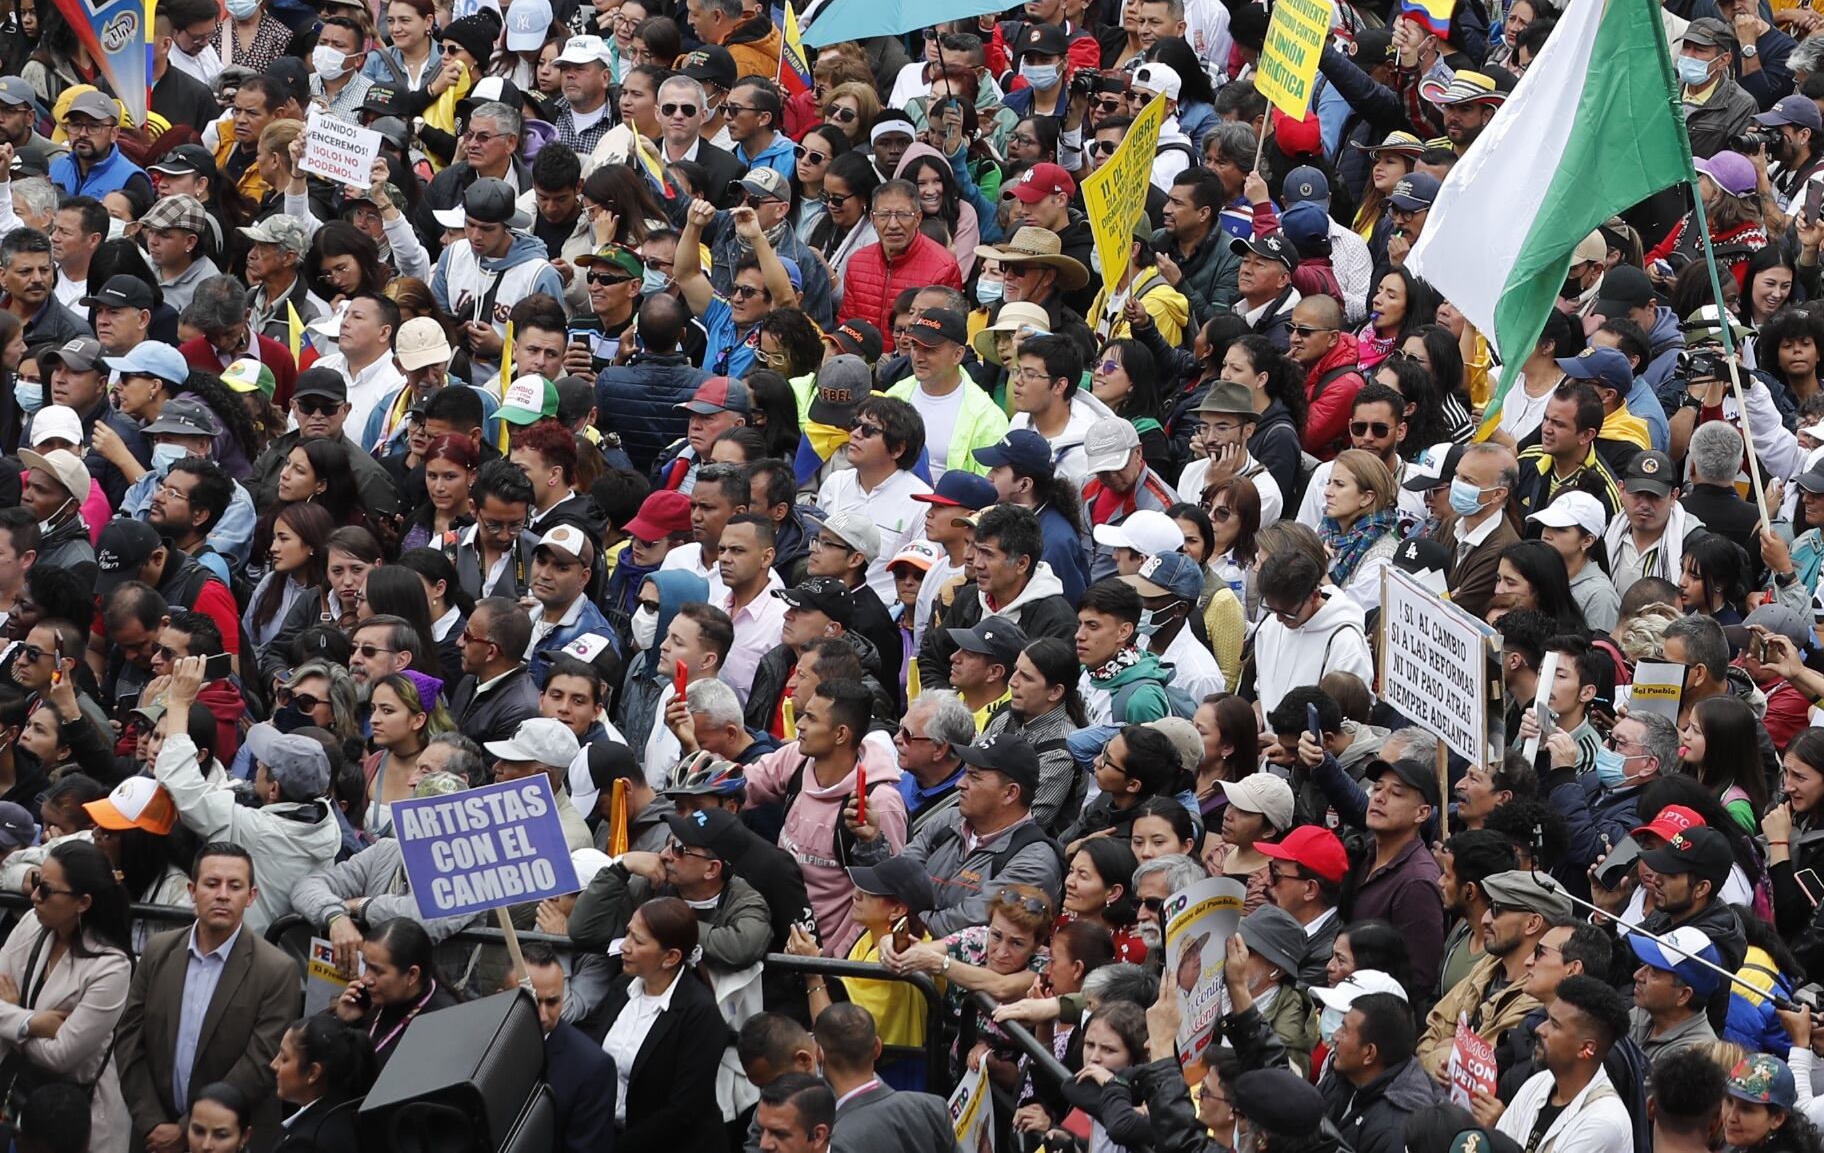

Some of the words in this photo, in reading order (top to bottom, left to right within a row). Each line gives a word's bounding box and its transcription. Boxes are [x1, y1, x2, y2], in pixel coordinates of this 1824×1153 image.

[783, 48, 805, 76] OMBIA
[307, 129, 368, 157] VENCEREMOS!
[344, 156, 359, 168] NO
[1100, 179, 1111, 200] 11
[1391, 622, 1400, 645] SI
[1401, 630, 1409, 649] A
[1410, 634, 1426, 664] LAS
[1428, 647, 1475, 699] REFORMAS
[1418, 612, 1430, 636] AL
[1432, 621, 1467, 662] CAMBIO
[1393, 652, 1404, 676] NI
[1406, 660, 1419, 687] UN
[1421, 670, 1444, 703] PASO
[1445, 687, 1472, 726] ATRÁS
[1633, 687, 1646, 695] del
[1647, 686, 1676, 696] Pueblo
[1388, 677, 1428, 722] SIEMPRE
[1430, 705, 1477, 759] ADELANTE!
[401, 785, 548, 842] ARTISTAS
[430, 836, 499, 873] CON
[498, 824, 538, 860] EL
[431, 858, 557, 911] CAMBIO
[1467, 1058, 1496, 1082] CON
